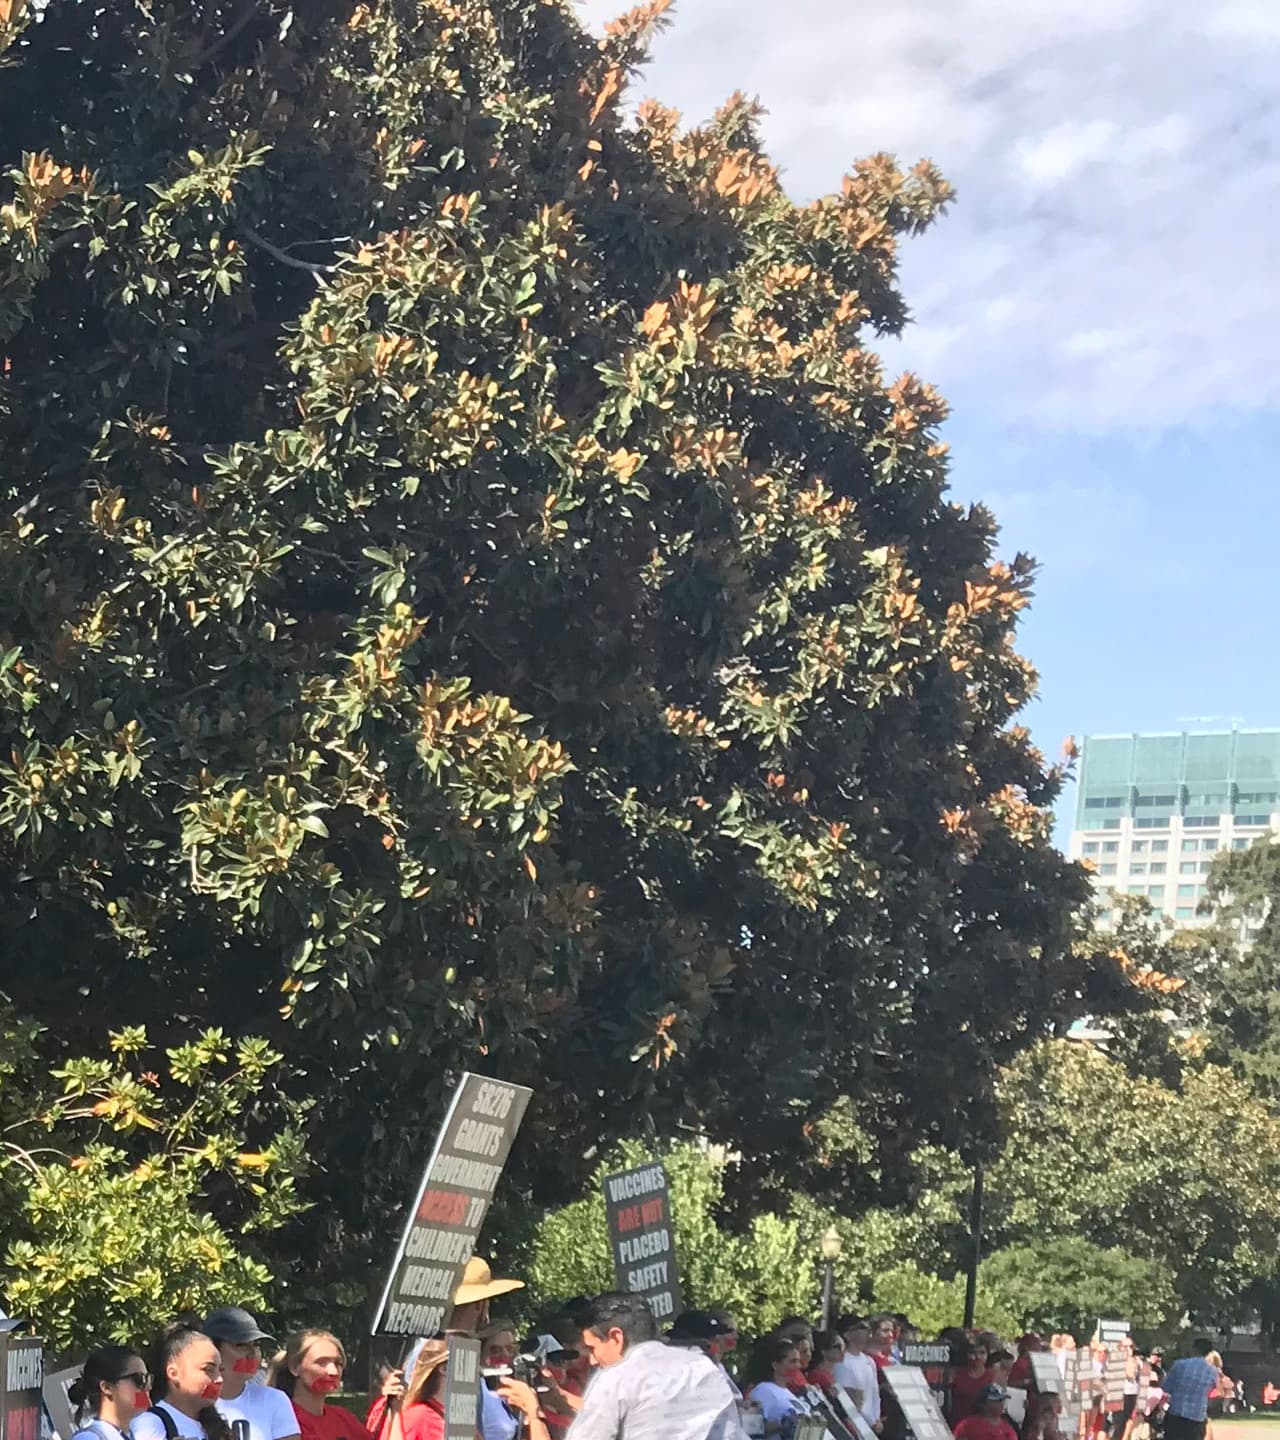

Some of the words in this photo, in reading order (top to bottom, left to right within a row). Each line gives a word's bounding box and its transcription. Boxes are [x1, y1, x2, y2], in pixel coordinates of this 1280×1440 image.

[472, 1082, 516, 1119] SB276
[453, 1118, 504, 1158] GRANTS
[609, 1165, 666, 1203] VACCINES
[465, 1197, 486, 1229] TO
[618, 1206, 641, 1233] ARE
[641, 1198, 663, 1226] NOT
[619, 1229, 670, 1265] PLACEBO
[399, 1265, 456, 1300] MEDICAL
[628, 1261, 668, 1292] SAFETY
[384, 1302, 446, 1337] RECORDS
